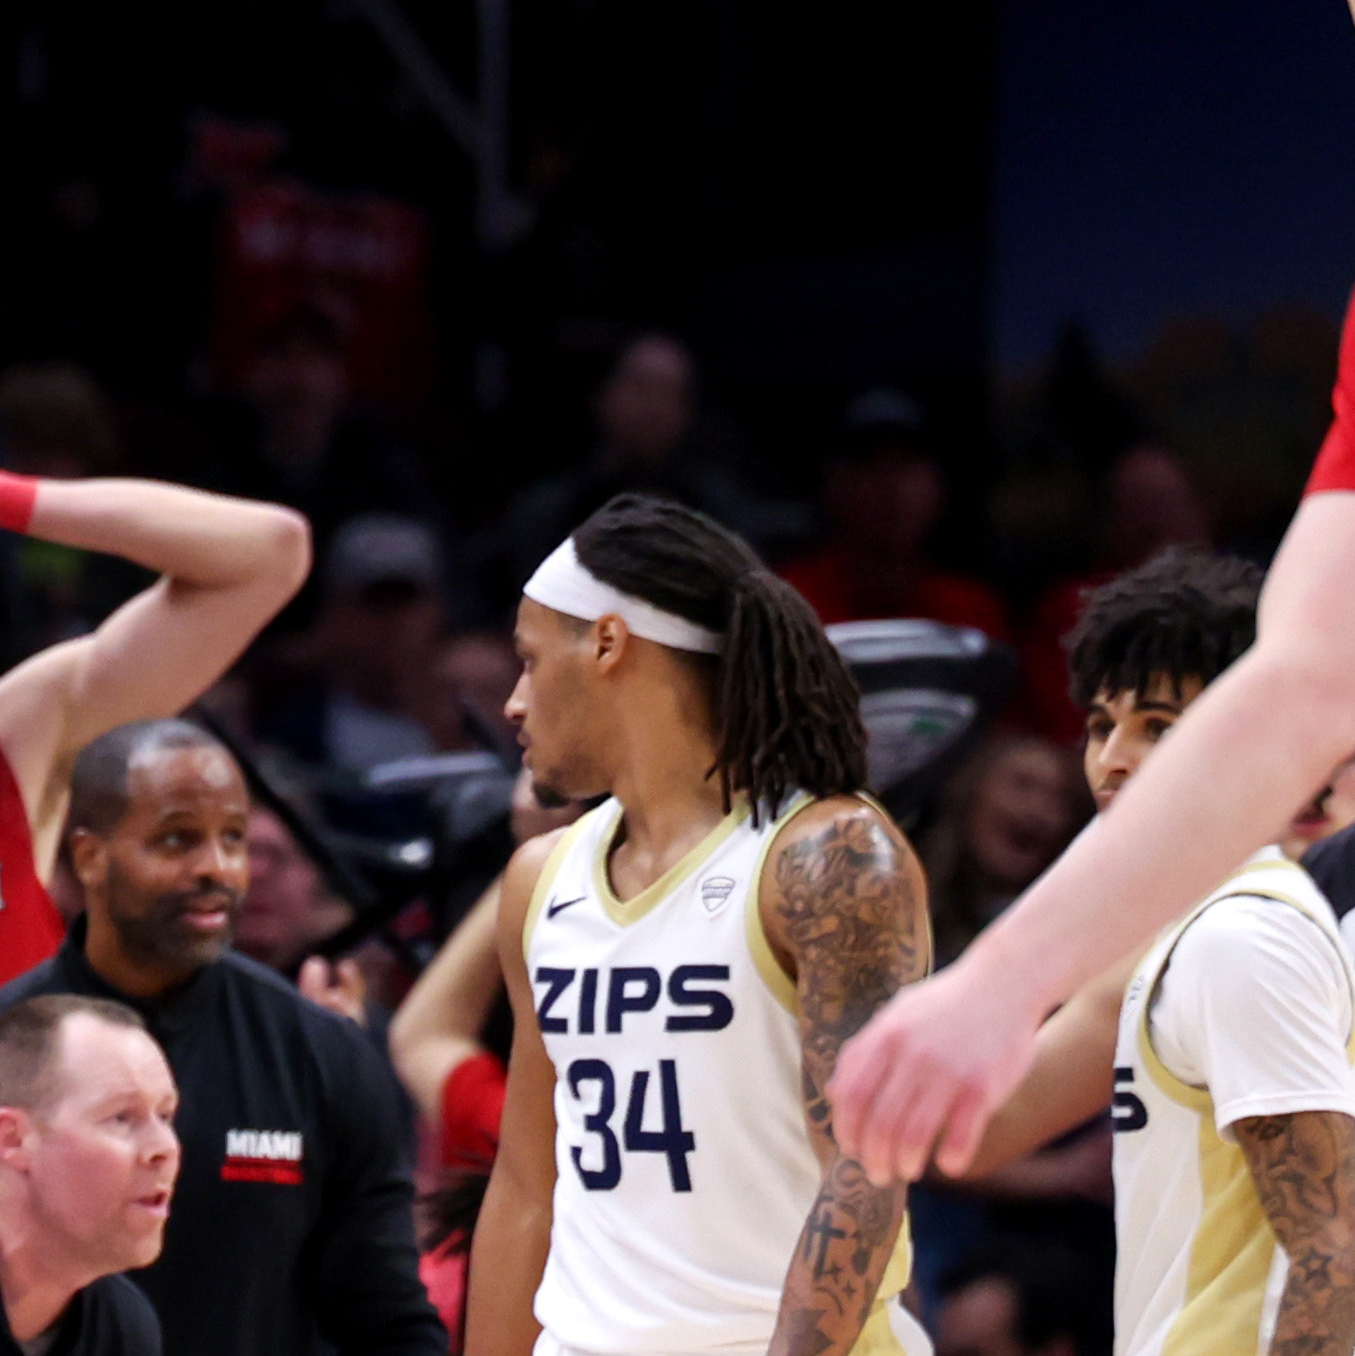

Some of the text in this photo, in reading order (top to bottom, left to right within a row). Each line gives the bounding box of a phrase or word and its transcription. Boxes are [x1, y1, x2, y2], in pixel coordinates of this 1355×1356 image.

[535, 964, 734, 1035] ZIPS
[226, 1129, 303, 1161] MIAMI
[566, 1058, 696, 1193] 34
